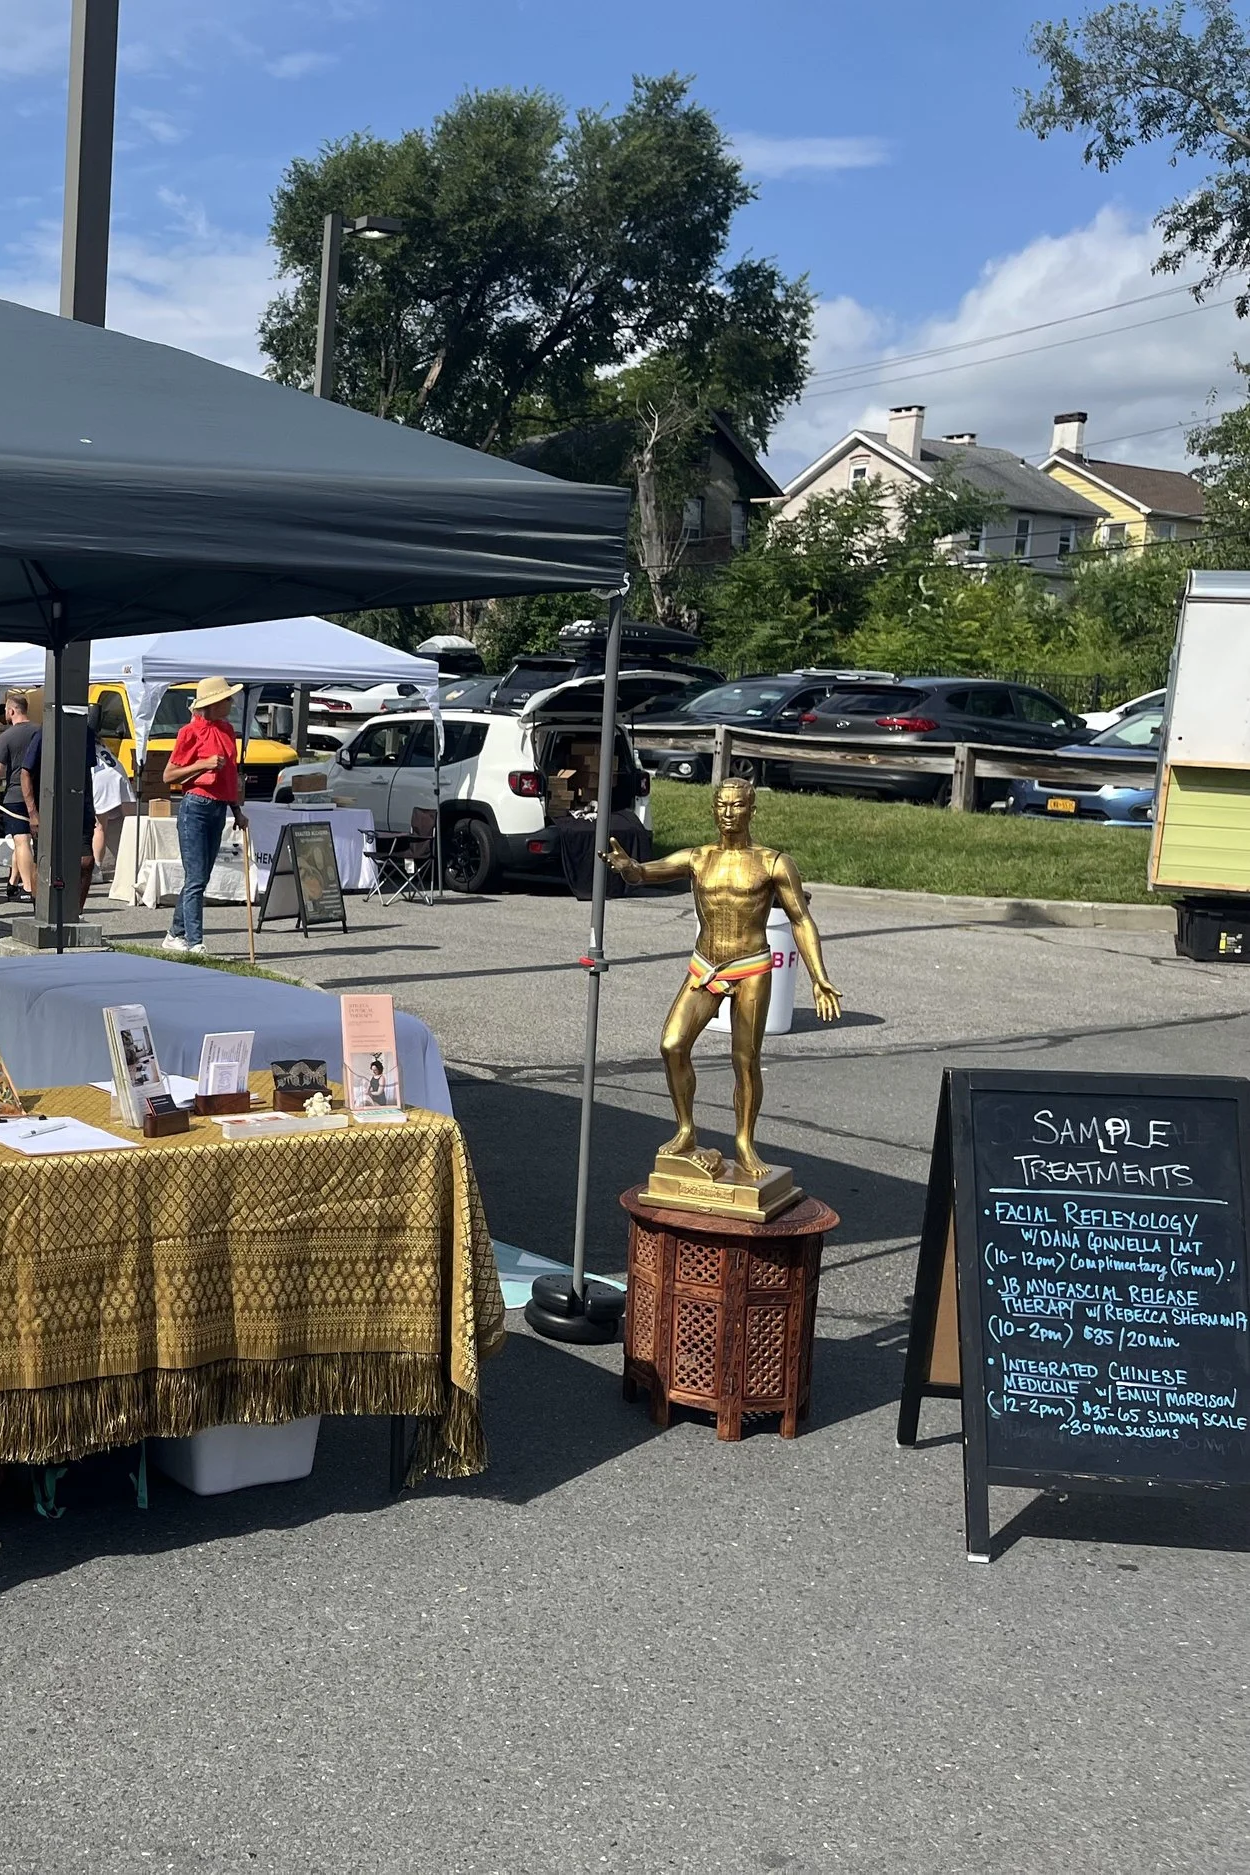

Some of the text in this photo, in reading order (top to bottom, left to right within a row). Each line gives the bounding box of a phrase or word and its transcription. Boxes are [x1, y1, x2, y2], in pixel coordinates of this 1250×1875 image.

[1033, 1110, 1171, 1152] SAMPLE
[1013, 1154, 1193, 1190] TREATMENTS
[995, 1201, 1198, 1238] FACIAL REFLEXOLOGY
[1170, 1237, 1203, 1256] LMT
[1070, 1252, 1168, 1282] Complimentary
[1026, 1278, 1123, 1301] MYOFASCIAL
[1129, 1285, 1199, 1306] RELEASE
[1001, 1297, 1074, 1320] THERAPY
[1104, 1303, 1168, 1325] REBECCA
[1001, 1352, 1188, 1385] INTEGRATED CHINESE
[1003, 1374, 1079, 1394] MEDICINE
[1165, 1388, 1237, 1408] MORRISON
[1147, 1410, 1199, 1429] SLIDING
[1202, 1412, 1248, 1430] SCALE
